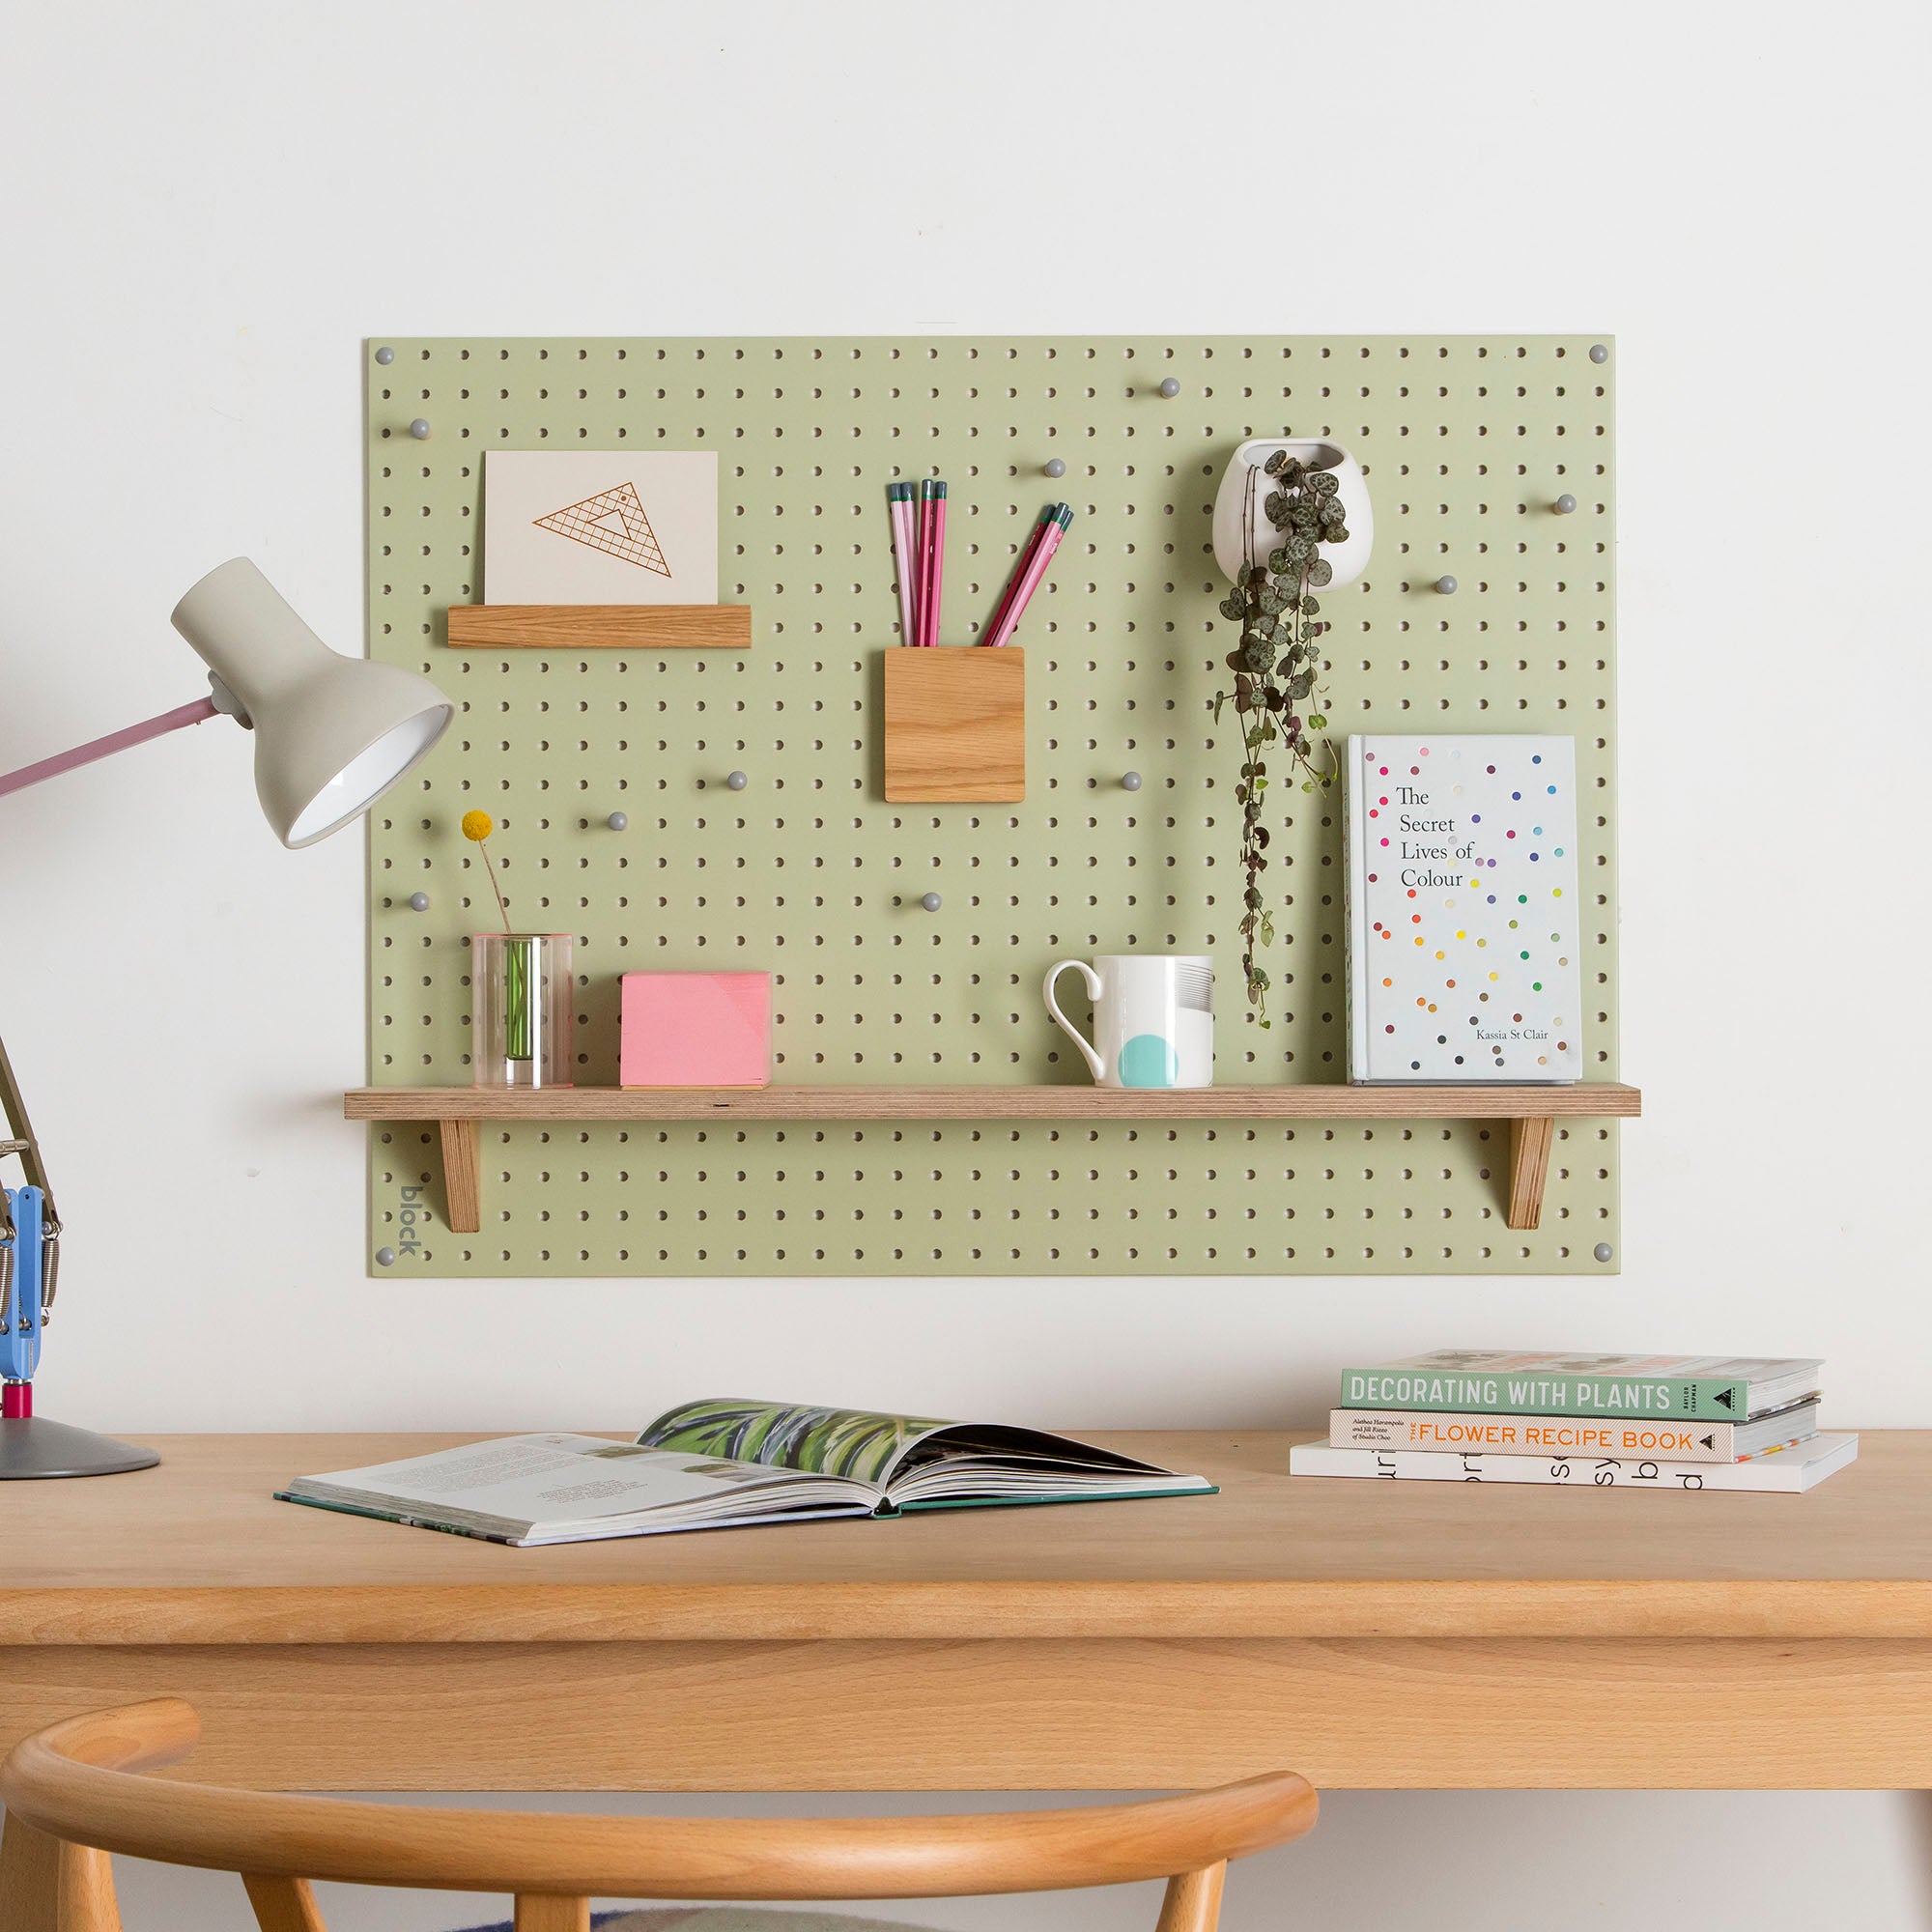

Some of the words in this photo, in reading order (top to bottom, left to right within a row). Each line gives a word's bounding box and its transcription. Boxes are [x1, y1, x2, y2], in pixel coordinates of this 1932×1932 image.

[1396, 787, 1429, 805] The
[1400, 814, 1455, 832] Secret
[1401, 841, 1448, 859] Lives
[1456, 841, 1475, 859] of
[1401, 868, 1463, 887] Colour
[1477, 1030, 1507, 1039] Kassia
[1510, 1029, 1520, 1039] St
[1523, 1029, 1548, 1039] Clair
[399, 1186, 423, 1257] block
[1350, 1377, 1497, 1405] DECORATING
[1508, 1380, 1566, 1406] WITH
[1577, 1382, 1670, 1410] PLANTS
[1419, 1424, 1517, 1443] FLOWER
[1526, 1428, 1612, 1447] RECIPE
[1623, 1431, 1692, 1450] BOOK
